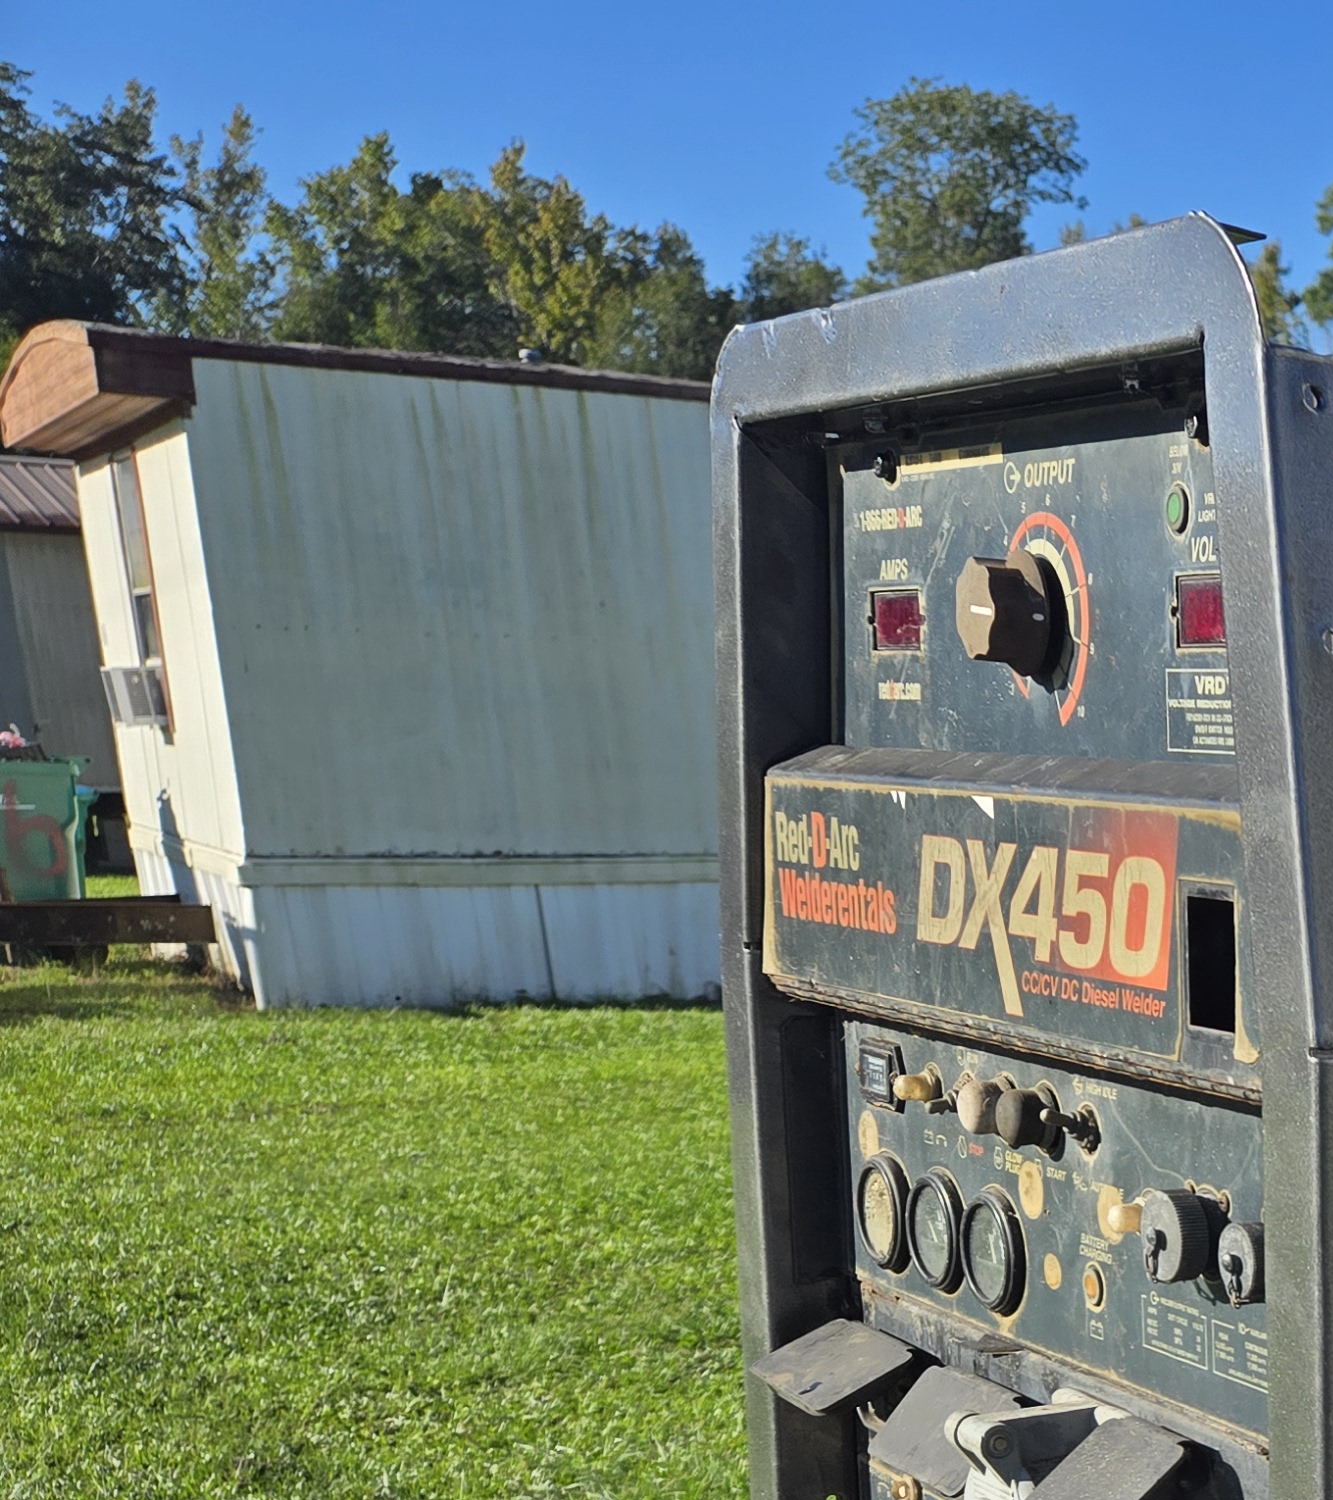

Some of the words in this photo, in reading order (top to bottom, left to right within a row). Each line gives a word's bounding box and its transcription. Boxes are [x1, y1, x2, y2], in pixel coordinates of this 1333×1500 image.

[1024, 458, 1076, 488] OUTPUT
[1191, 536, 1217, 562] VOL
[879, 558, 908, 582] AMPS
[775, 811, 860, 871] Red-D-Arc
[778, 867, 897, 935] Welderentals
[917, 834, 1167, 1018] DX450
[1021, 970, 1059, 997] CC/CV
[1061, 978, 1079, 1001] DC
[1082, 981, 1120, 1009] Diesel
[1122, 989, 1166, 1018] Welder
[1046, 1167, 1067, 1182] START
[1079, 1243, 1114, 1265] CHARGING
[1080, 1233, 1109, 1252] BATTERY
